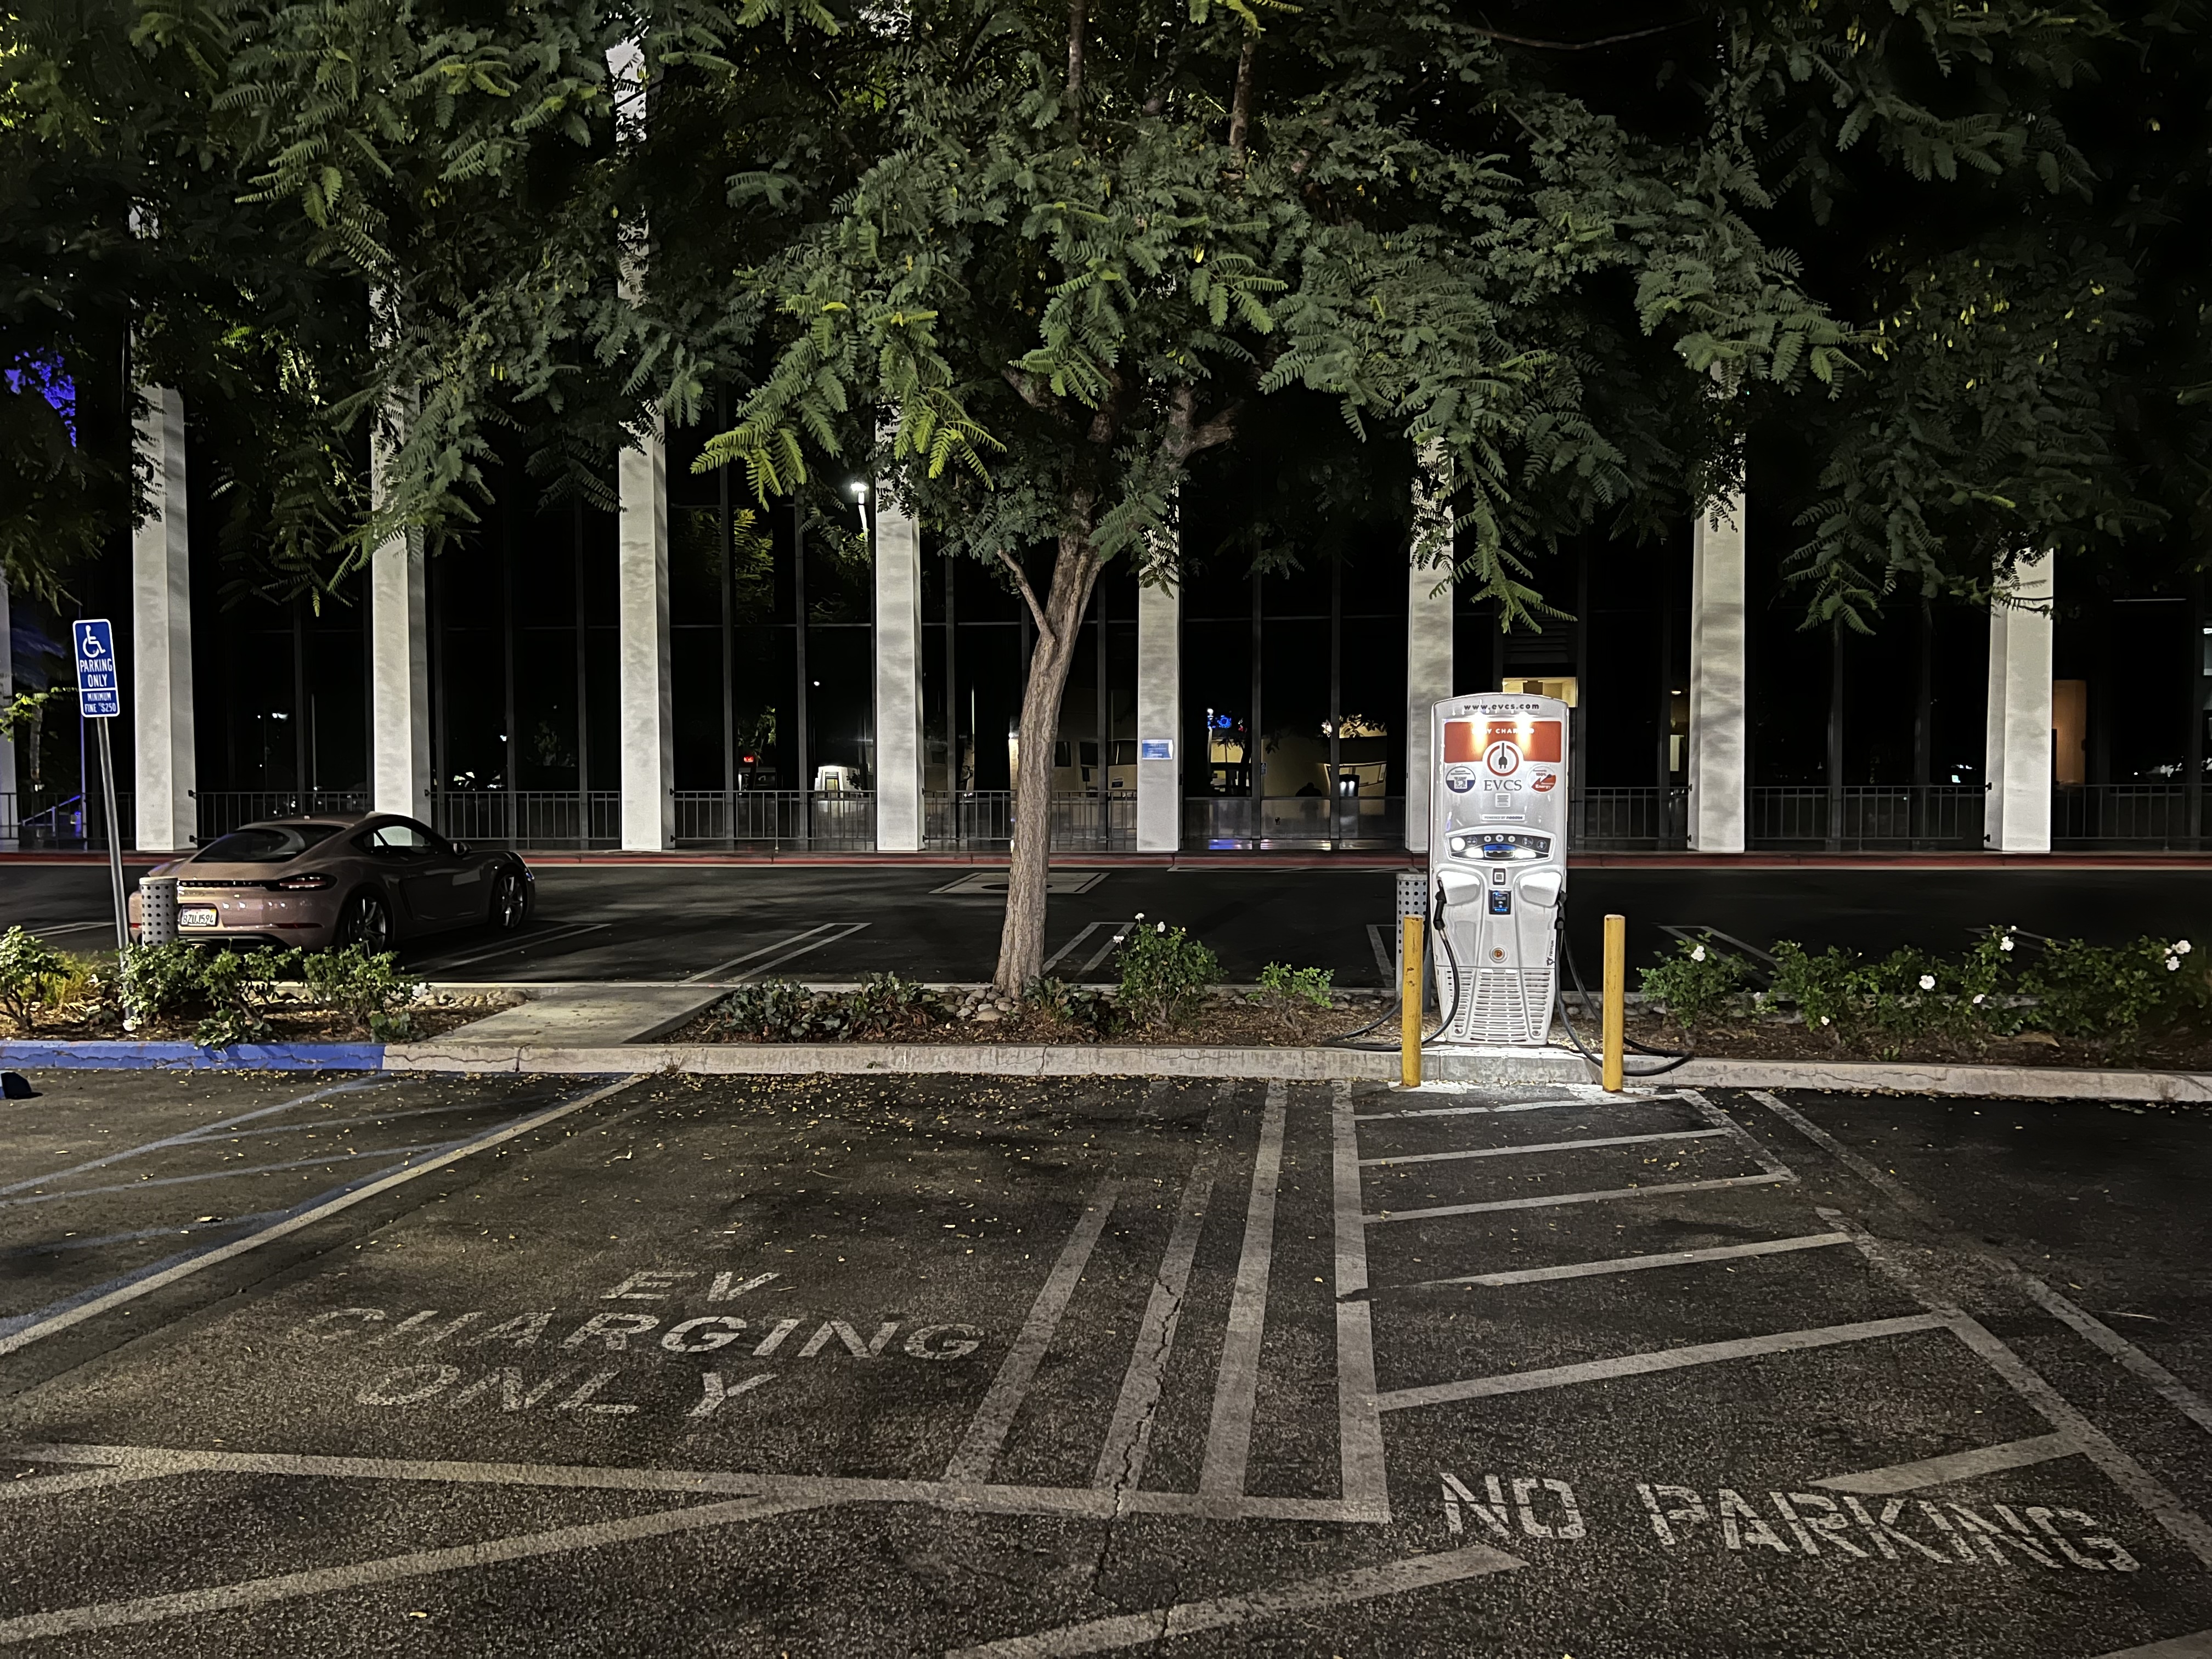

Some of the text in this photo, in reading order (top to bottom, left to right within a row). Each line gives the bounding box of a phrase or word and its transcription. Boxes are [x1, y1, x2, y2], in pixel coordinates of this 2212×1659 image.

[80, 658, 112, 672] PARKING
[87, 674, 108, 687] ONLY
[87, 692, 111, 702] MINIMUM
[84, 703, 97, 713] FINE
[1483, 780, 1522, 791] EVCS
[600, 1271, 780, 1301] EV
[357, 1364, 777, 1417] ONLY
[1439, 1472, 2141, 1572] NO PARKING
